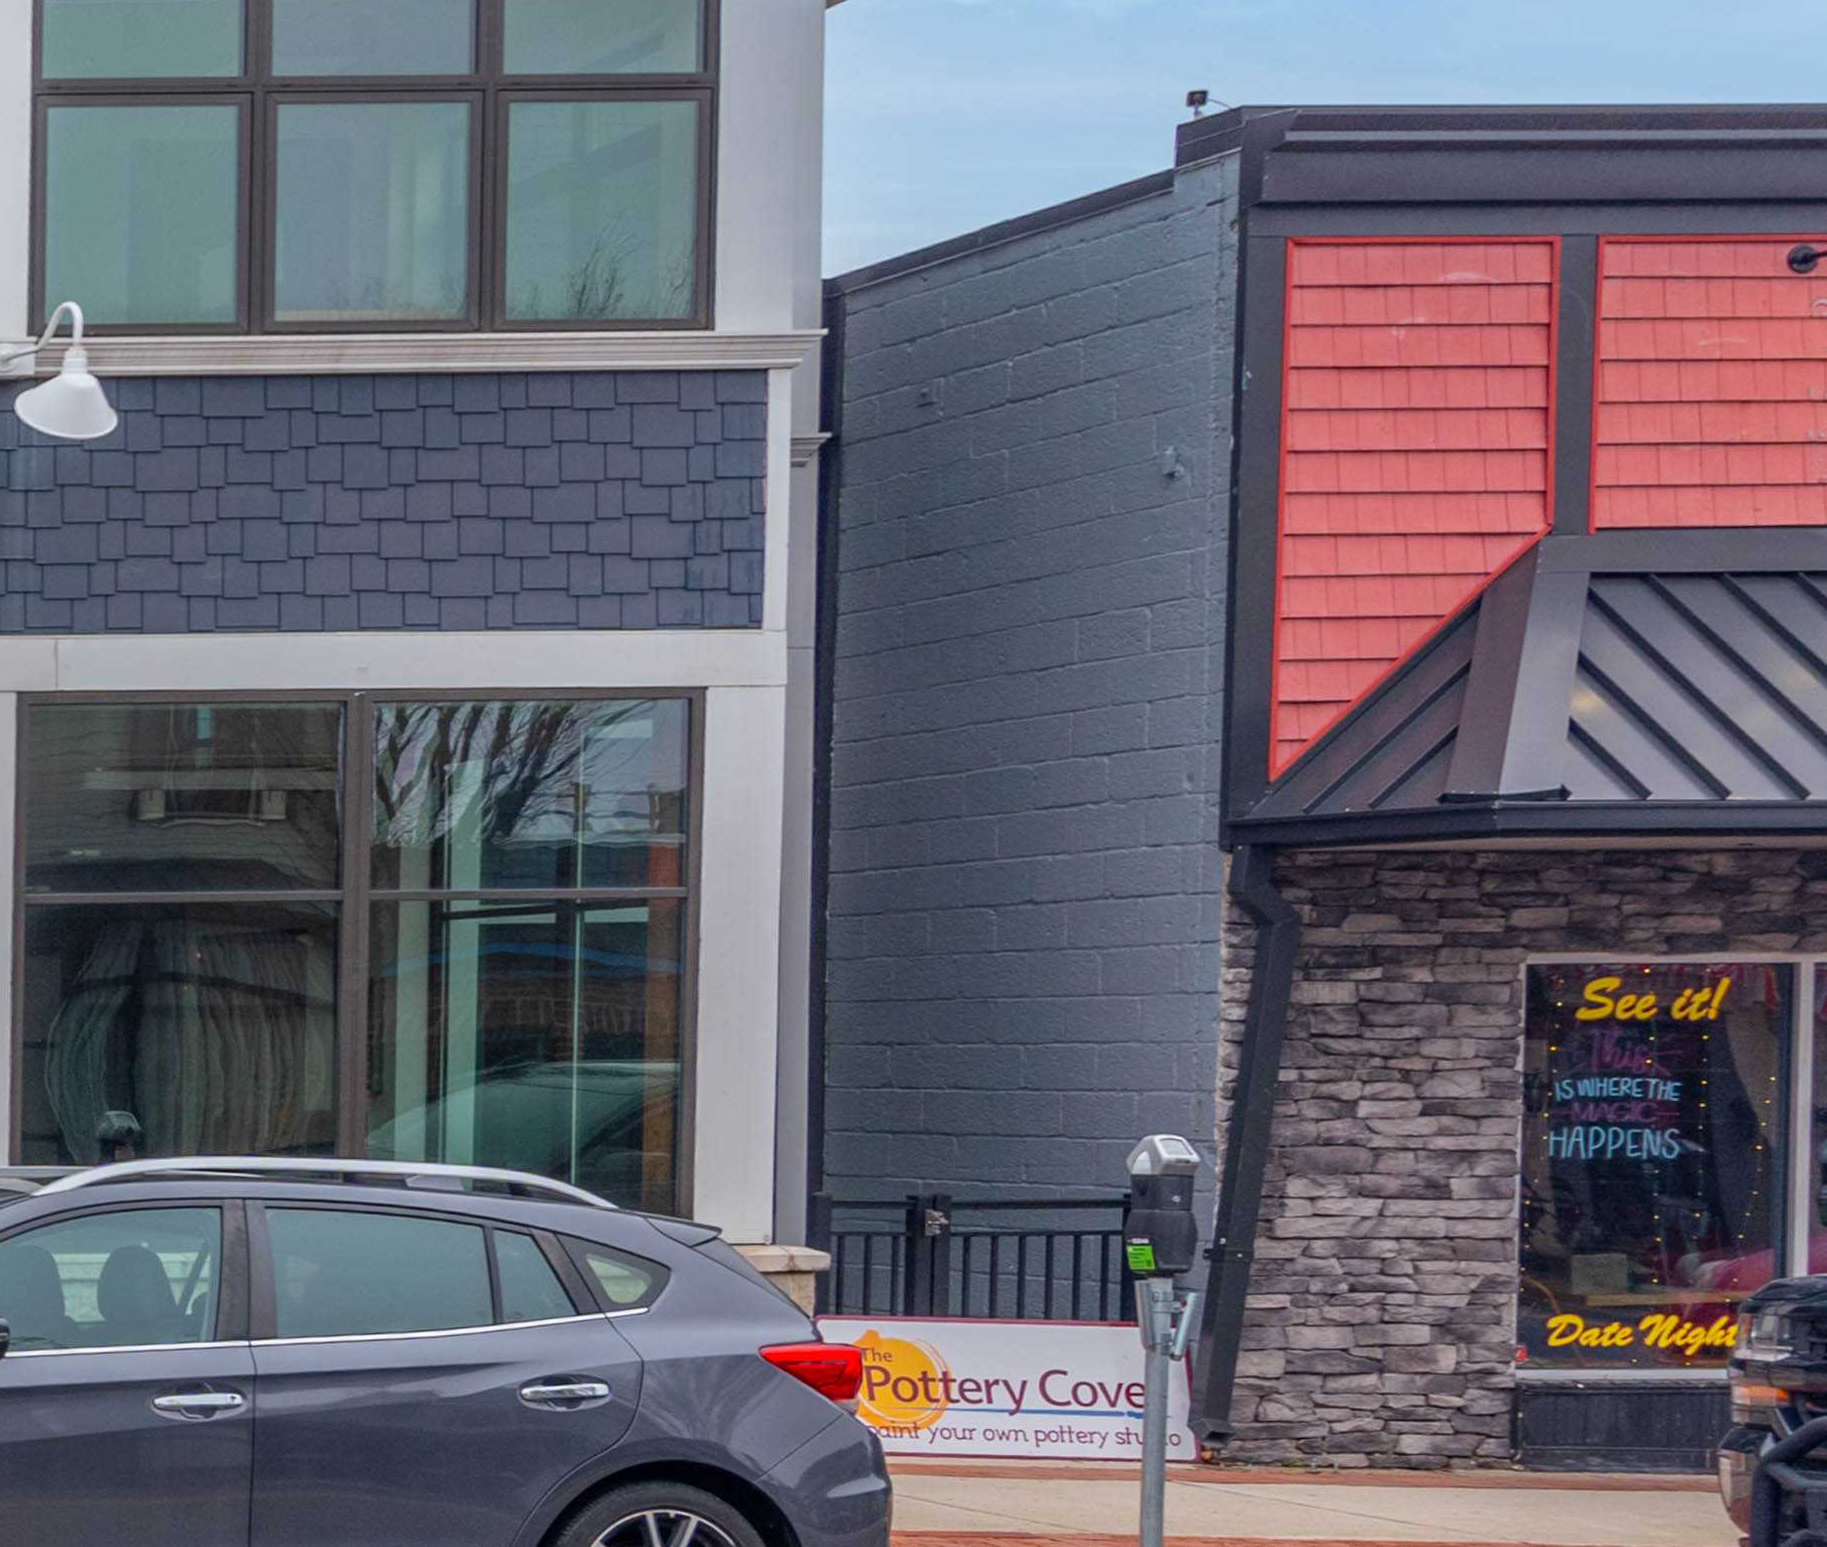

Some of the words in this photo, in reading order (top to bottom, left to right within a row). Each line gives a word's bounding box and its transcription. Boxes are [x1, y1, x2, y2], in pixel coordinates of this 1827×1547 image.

[1575, 976, 1659, 1021] See
[1671, 976, 1732, 1021] it!
[1554, 1079, 1575, 1101] IS
[1577, 1077, 1644, 1097] WHERE
[1645, 1077, 1683, 1102] THE
[1548, 1125, 1681, 1159] HAPPENS
[1546, 1313, 1634, 1348] Date
[1638, 1313, 1739, 1356] Night
[861, 1347, 893, 1363] The
[865, 1364, 1028, 1416] Pottery
[1038, 1368, 1146, 1409] Cove
[928, 1425, 976, 1444] your
[982, 1427, 1029, 1443] own
[1035, 1425, 1109, 1448] pottery
